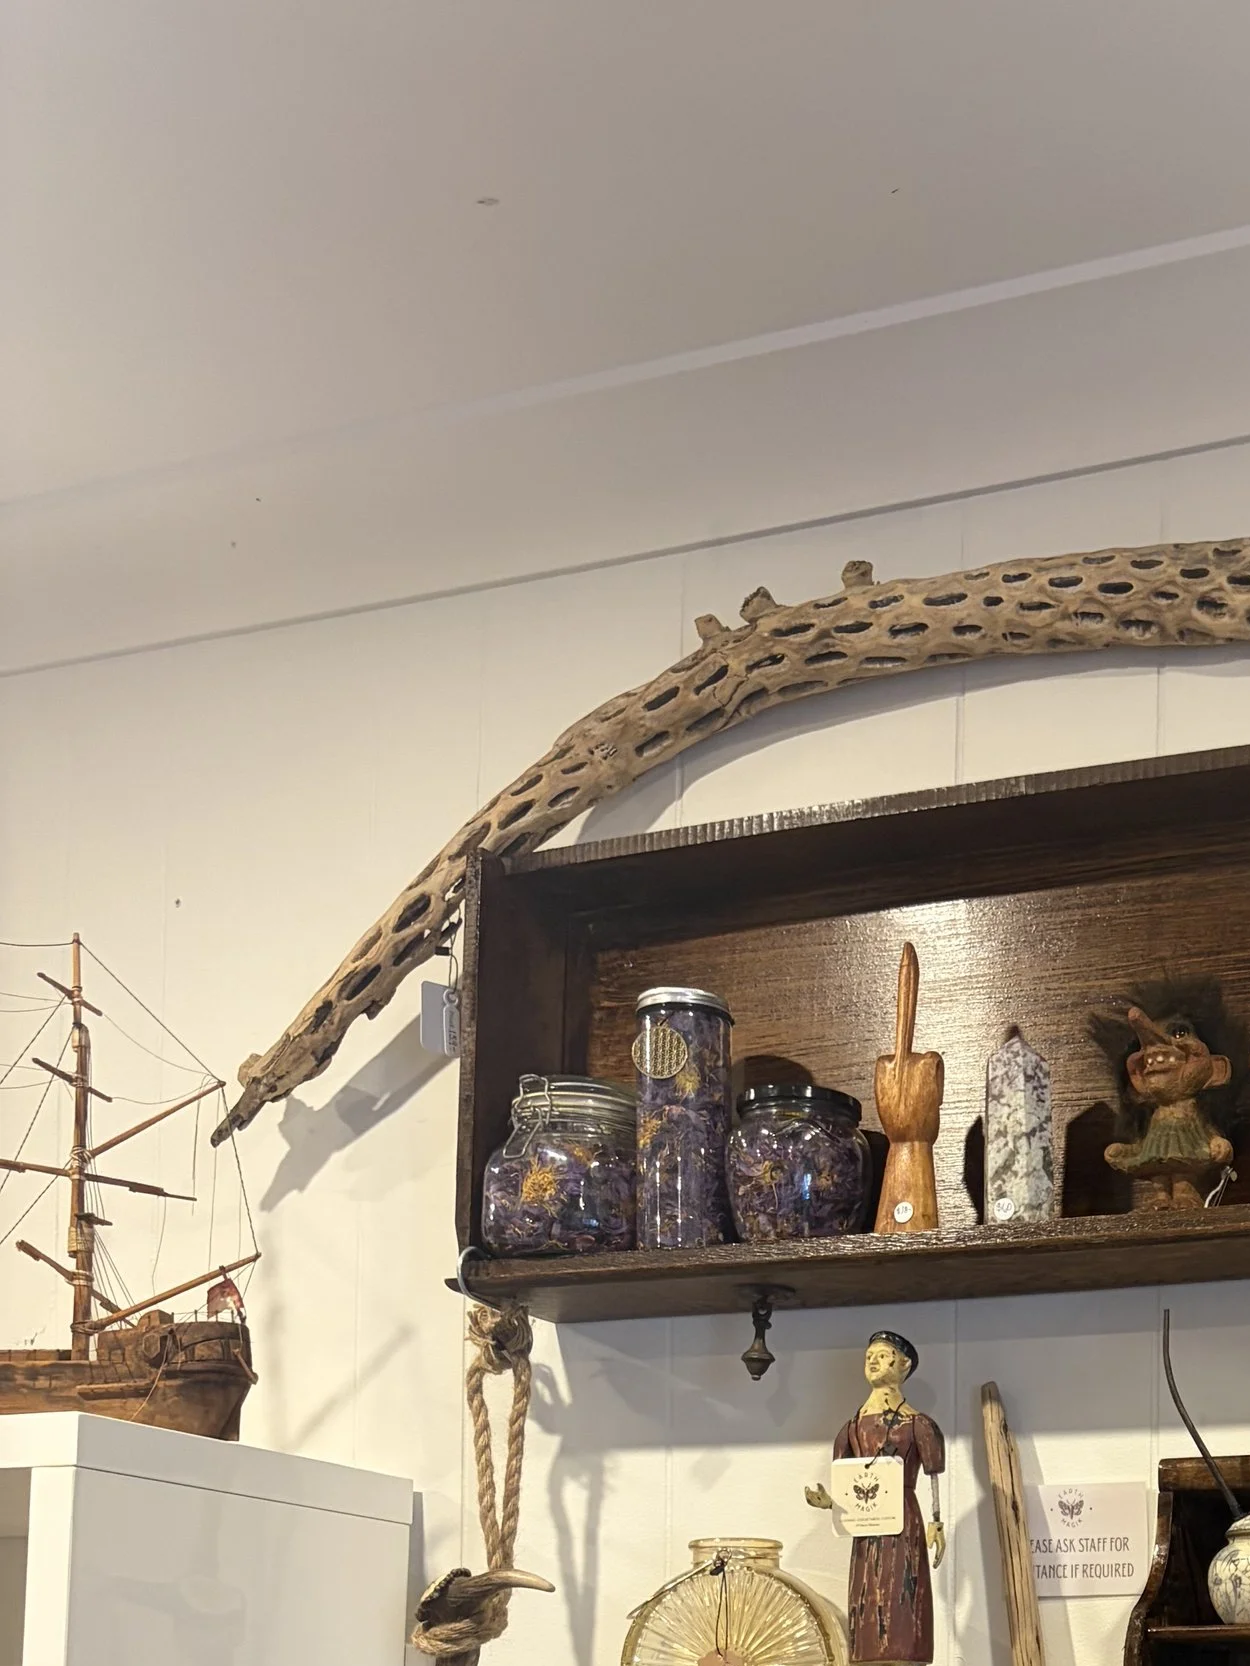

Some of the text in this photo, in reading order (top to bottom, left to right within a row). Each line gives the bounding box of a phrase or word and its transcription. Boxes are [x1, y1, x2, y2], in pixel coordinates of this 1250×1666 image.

[1060, 1518, 1083, 1529] MAGIK
[1030, 1536, 1130, 1554] EASE ASK STAFF FOR
[1070, 1563, 1080, 1579] IF
[1082, 1562, 1135, 1579] REQUIRED
